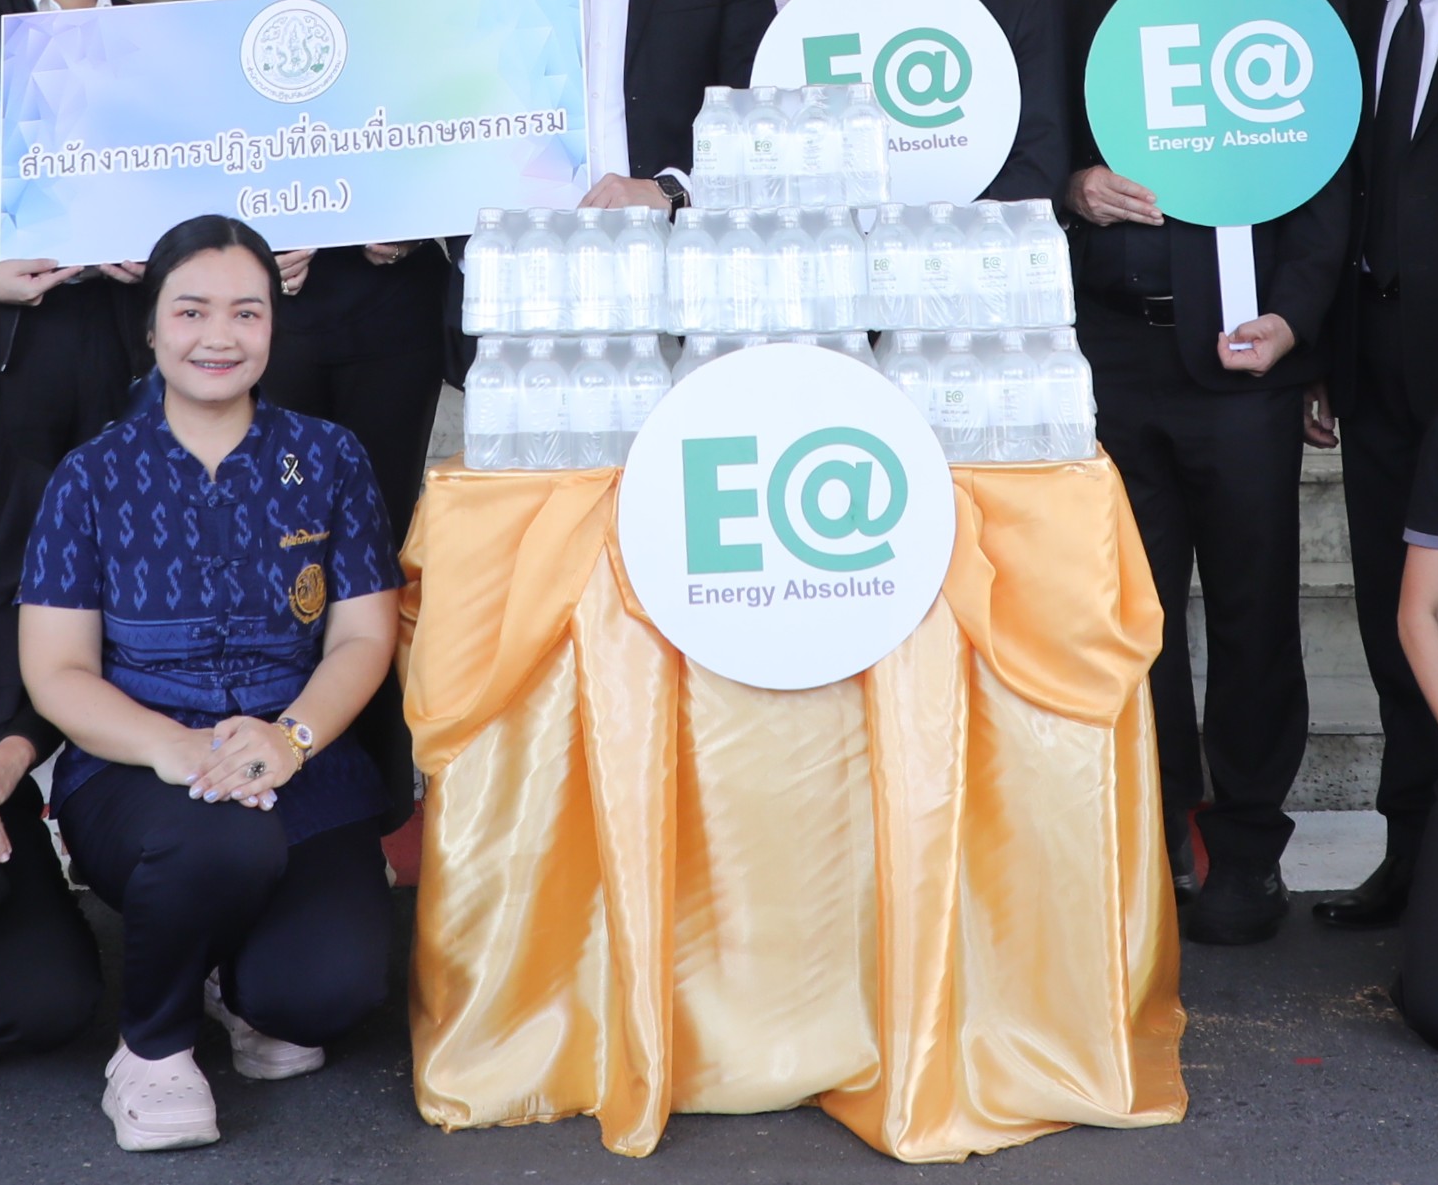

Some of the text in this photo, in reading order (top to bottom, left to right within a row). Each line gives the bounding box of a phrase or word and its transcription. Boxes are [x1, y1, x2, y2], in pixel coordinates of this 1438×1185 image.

[1140, 20, 1314, 130] E@
[22, 109, 565, 177] สำนักงานการปฏิรูปที่ดินเพื่อเกษตรกรรม
[888, 134, 968, 153] Absolute
[1149, 128, 1308, 152] Energy Absolute
[239, 181, 350, 218] (ส.ป.ก.)
[682, 426, 908, 575] E@
[688, 577, 896, 607] Energy Absolute
